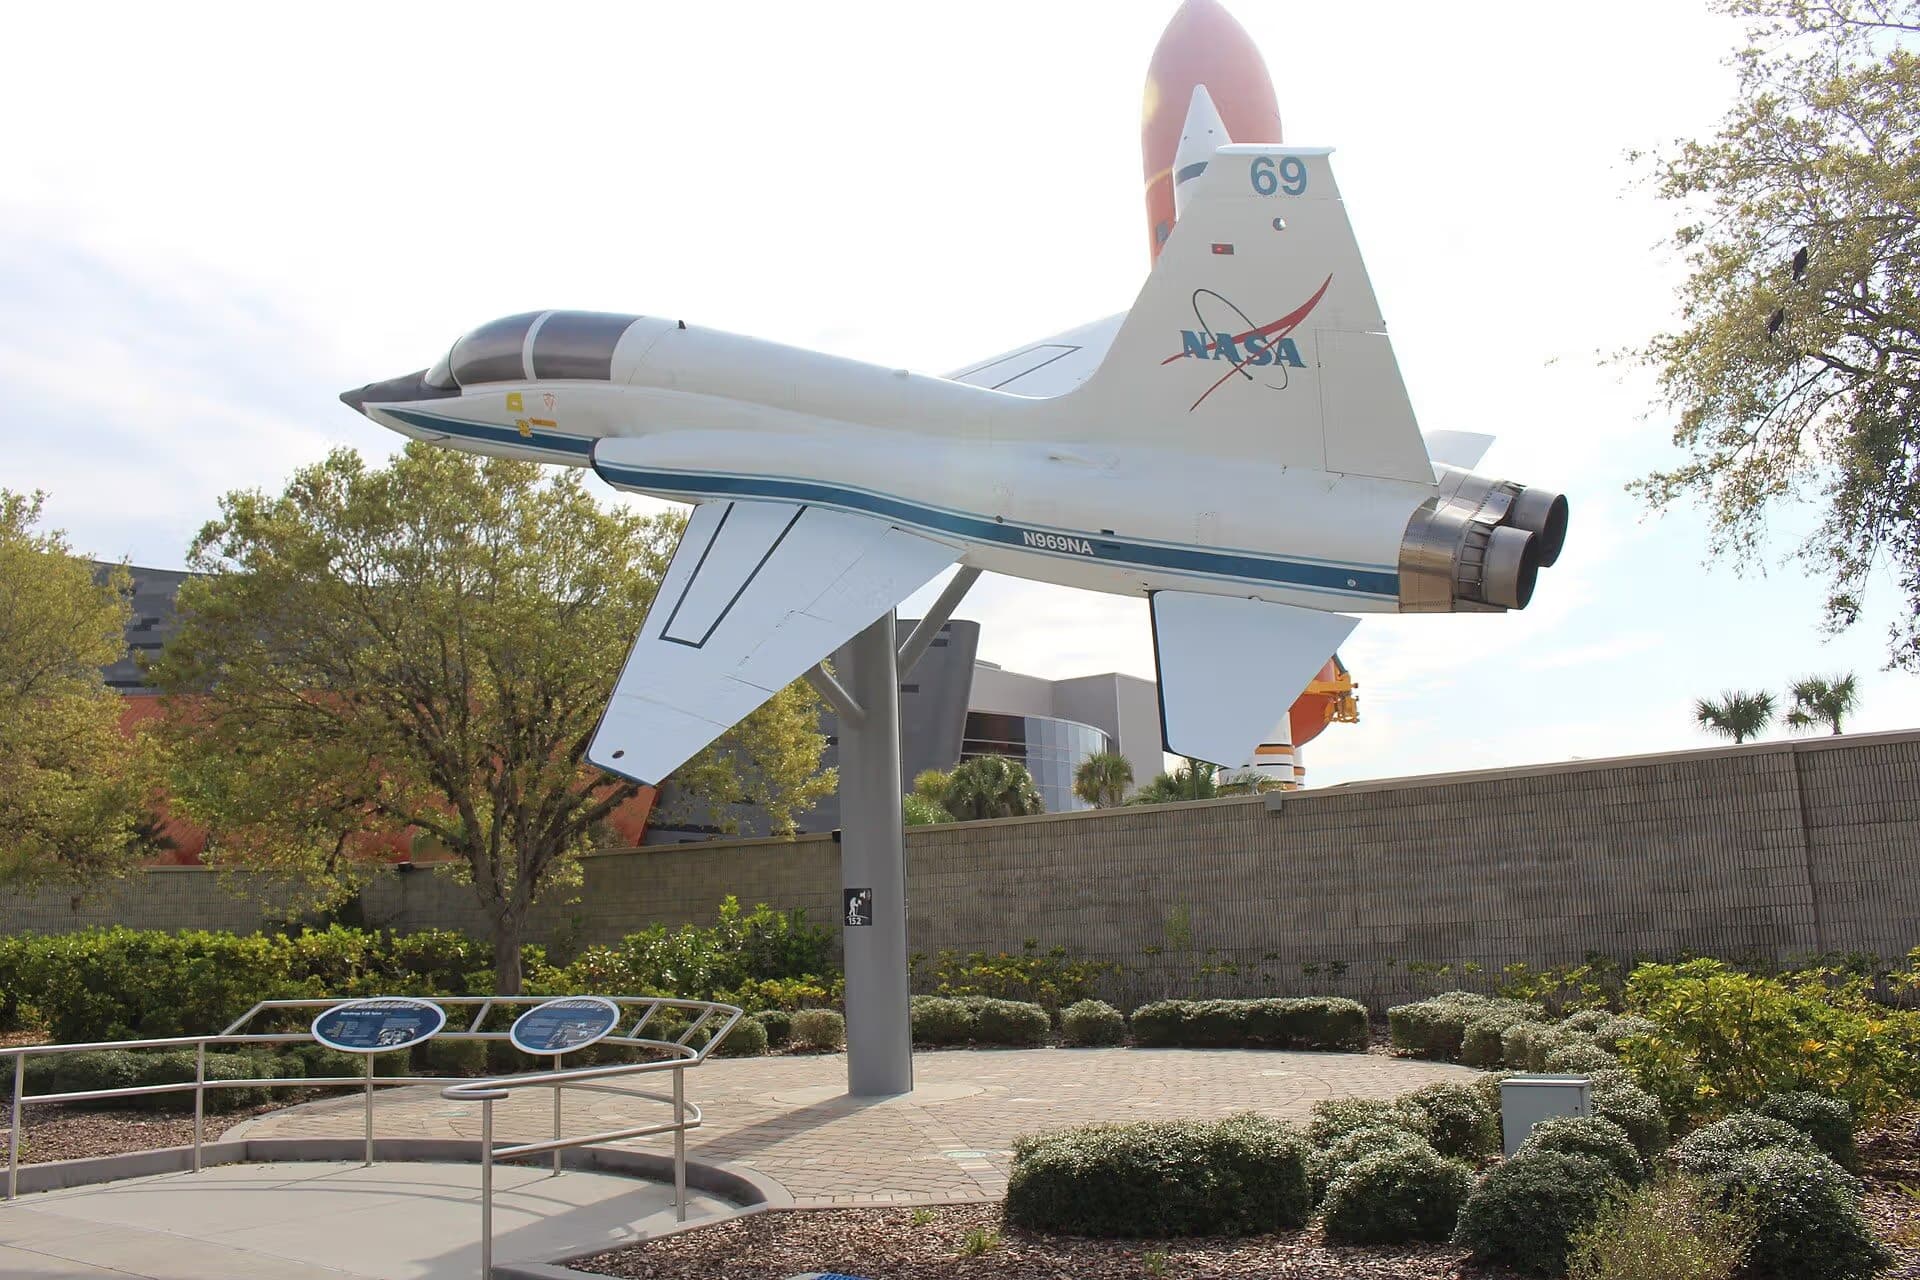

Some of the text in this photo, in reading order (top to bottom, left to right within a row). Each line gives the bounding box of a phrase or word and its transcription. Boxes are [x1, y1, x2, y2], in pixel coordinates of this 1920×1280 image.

[1250, 156, 1307, 196] 69
[1180, 330, 1307, 368] NASA
[1023, 531, 1094, 555] N969NA
[848, 917, 862, 925] 152
